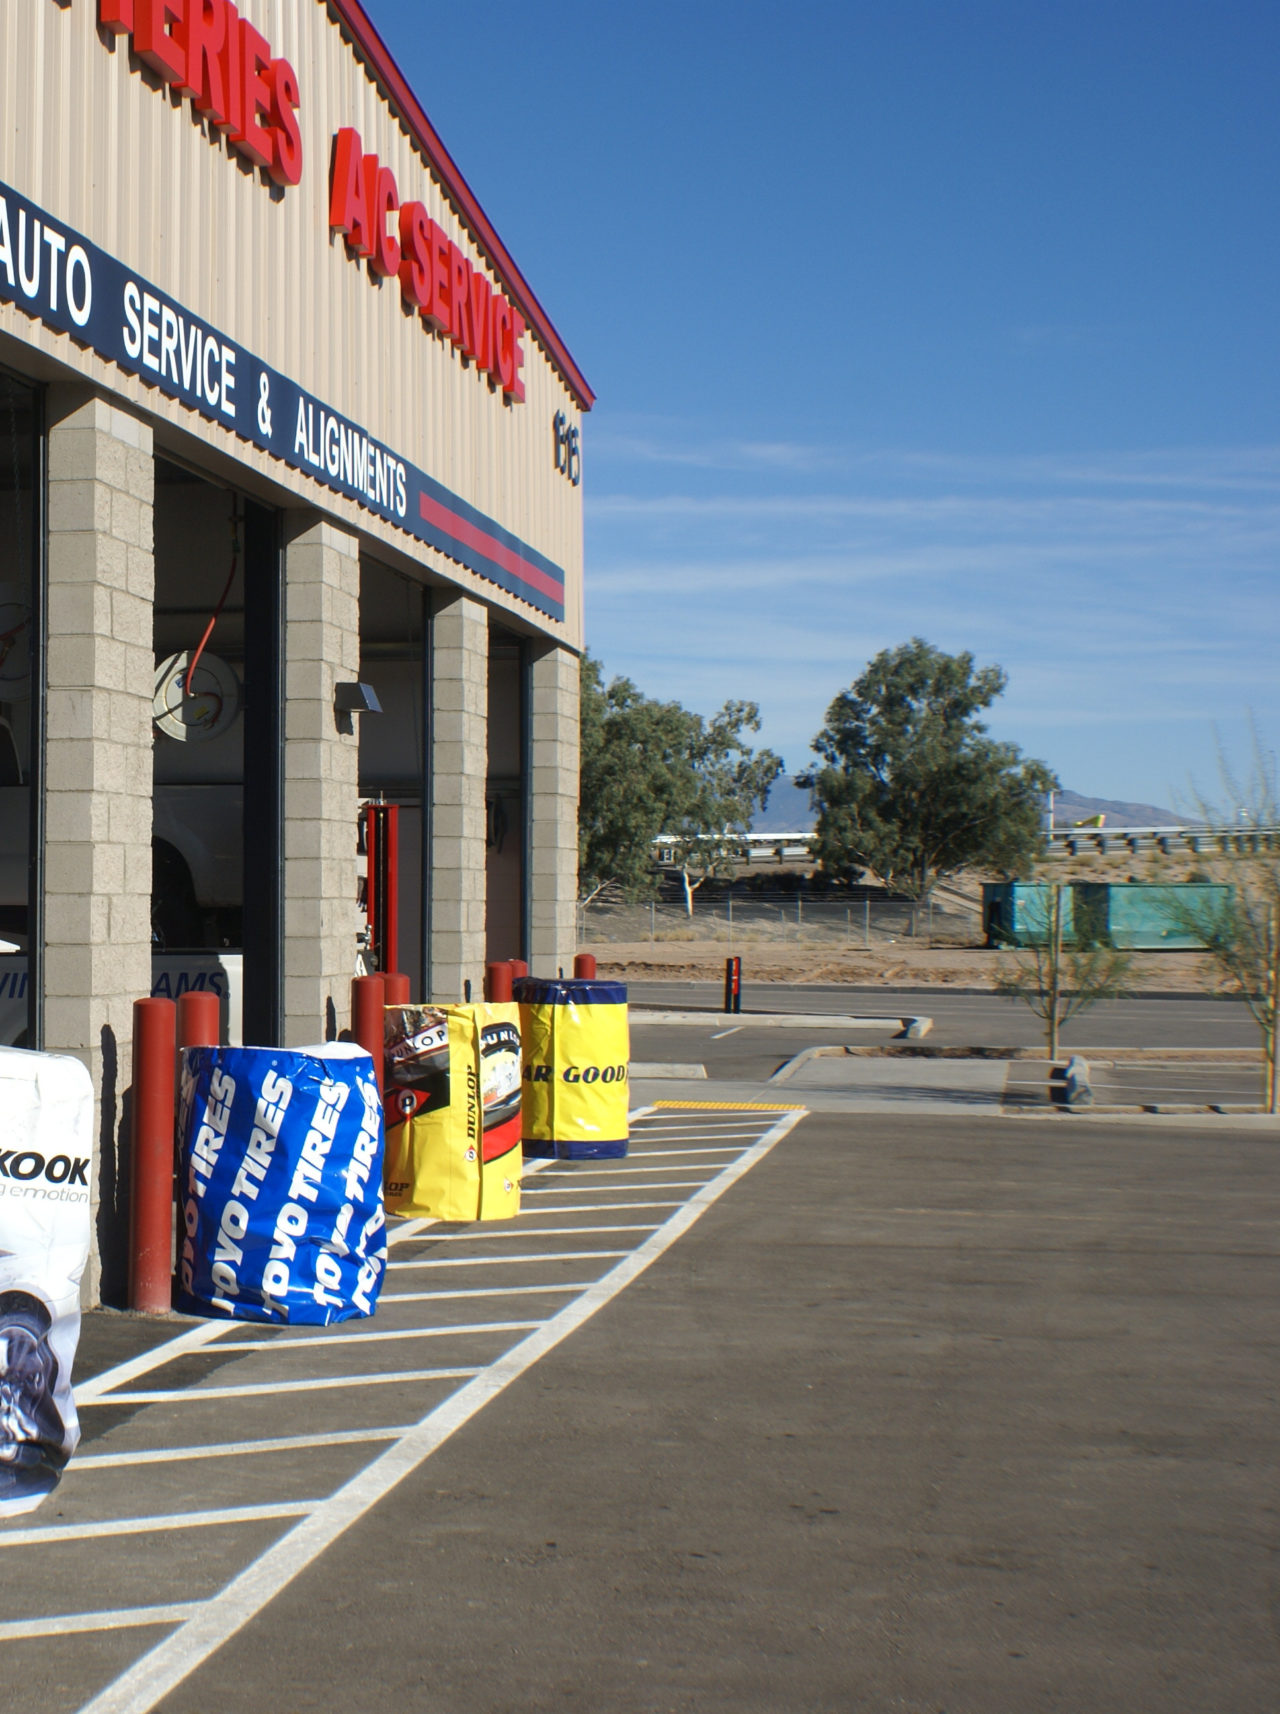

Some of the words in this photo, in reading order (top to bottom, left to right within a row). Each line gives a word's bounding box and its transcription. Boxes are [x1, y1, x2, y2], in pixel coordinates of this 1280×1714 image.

[101, 0, 303, 186] ERIES
[399, 201, 526, 403] SERVICE
[122, 280, 236, 418] SERVICE
[257, 371, 273, 439] &
[293, 395, 407, 518] ALIGNMENTS
[188, 1066, 236, 1199] TIRES
[231, 1069, 293, 1200] TIRES
[288, 1080, 350, 1203] TIRES
[344, 1075, 383, 1203] TIRES
[467, 1065, 479, 1140] DUNLOP
[9, 1183, 89, 1204] emotion
